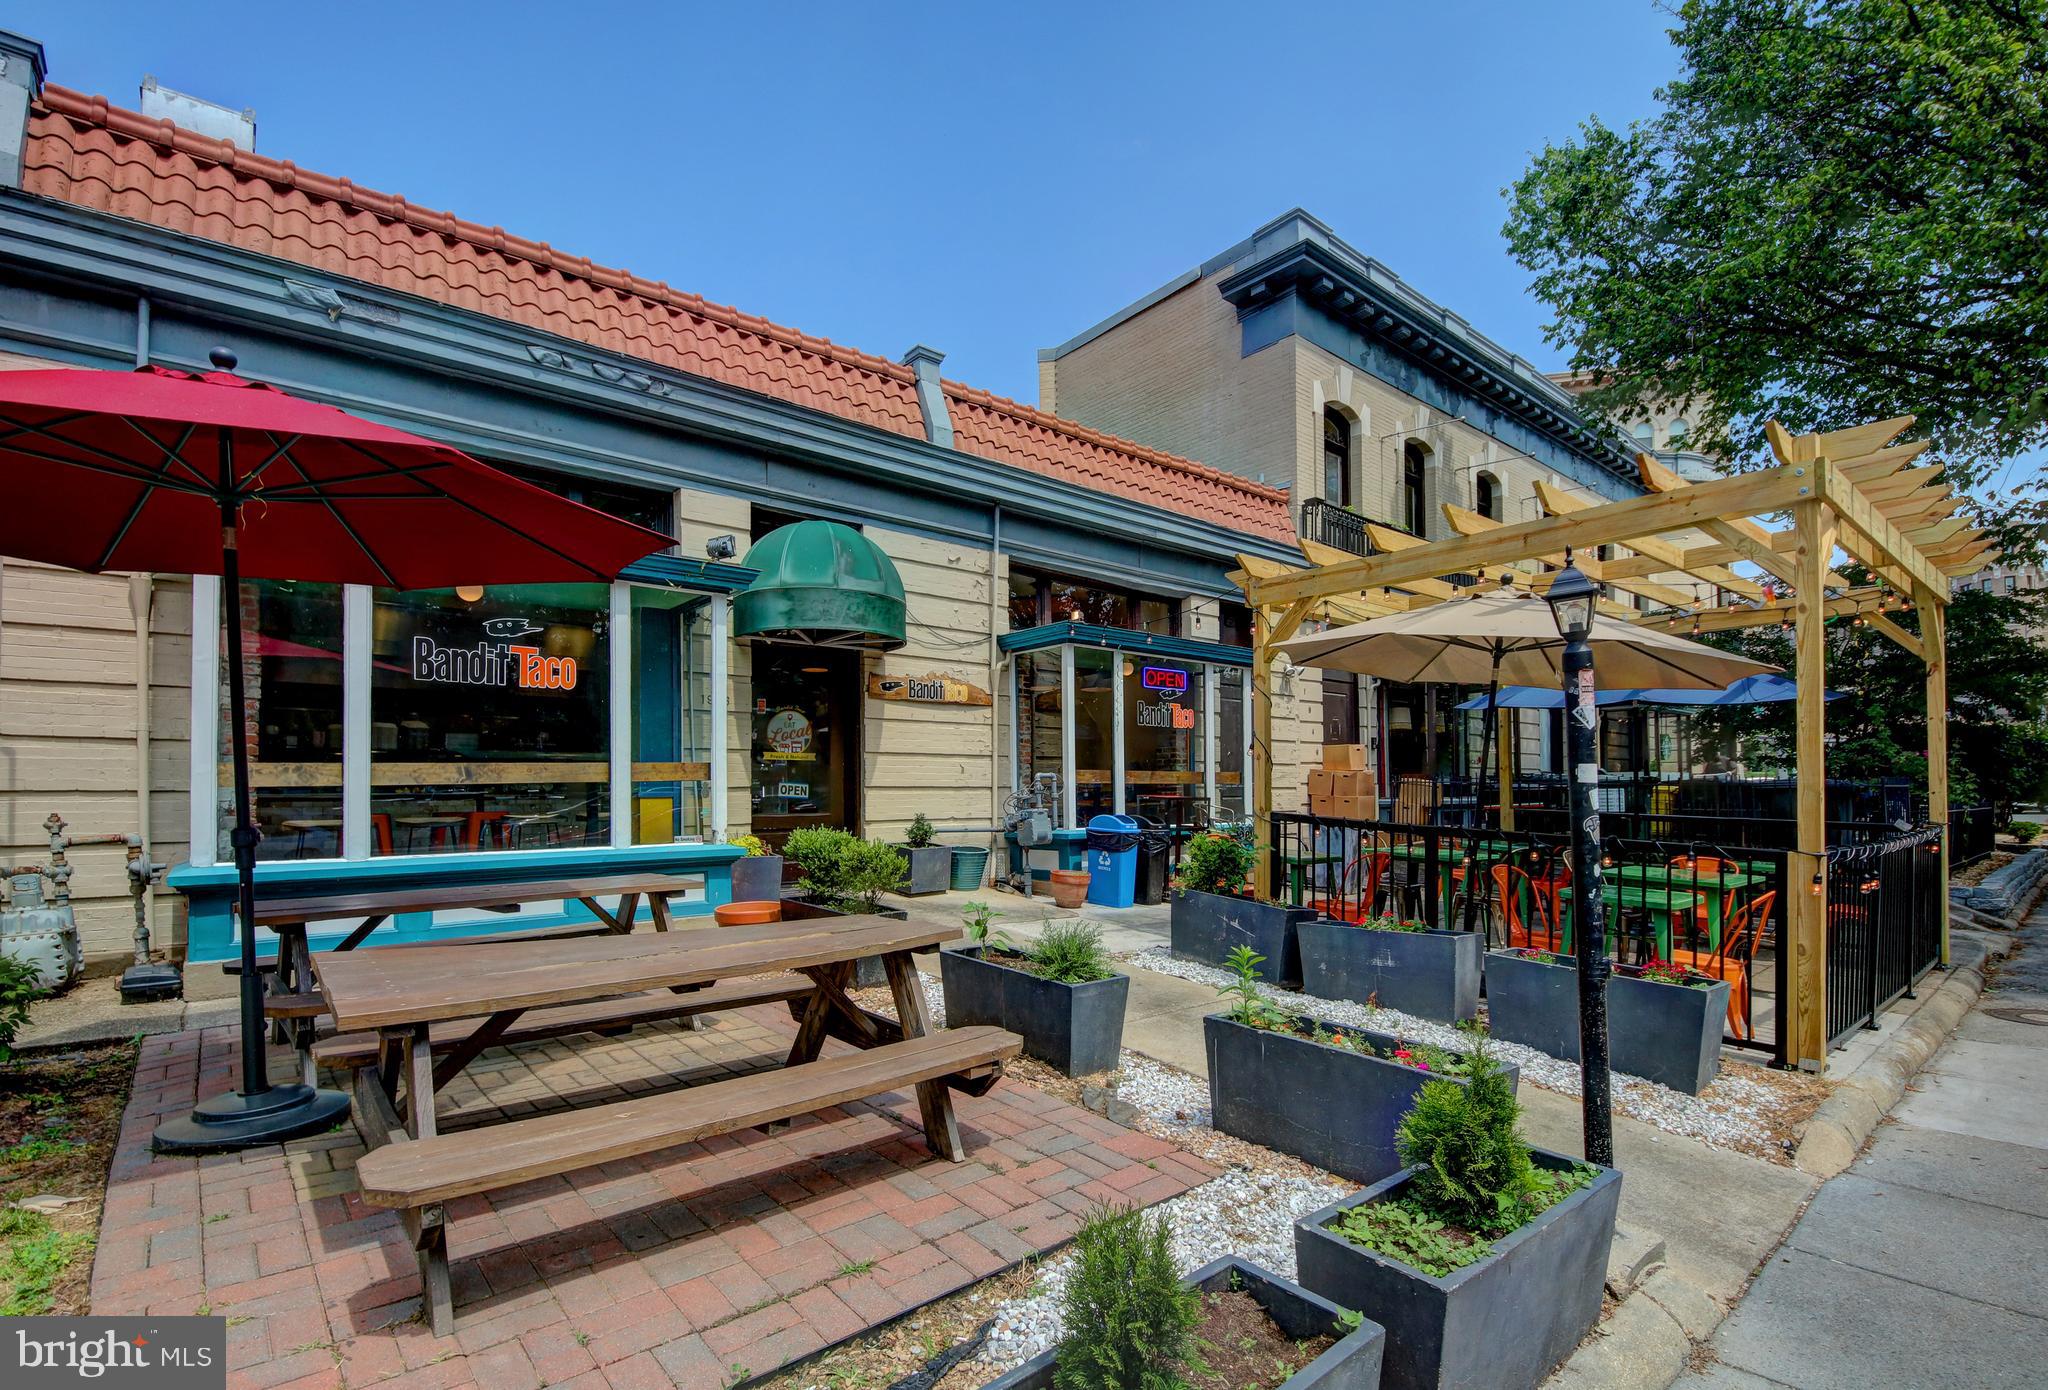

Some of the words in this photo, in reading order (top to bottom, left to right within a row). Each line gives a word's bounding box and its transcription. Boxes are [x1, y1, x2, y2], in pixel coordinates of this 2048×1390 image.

[413, 636, 511, 686] Bandit
[510, 645, 577, 690] Taco
[908, 679, 944, 700] Bandit
[1145, 670, 1184, 687] OPEN
[1137, 700, 1171, 727] Bandit
[1170, 703, 1194, 729] Taco
[768, 720, 813, 745] Local
[780, 785, 807, 796] OPEN
